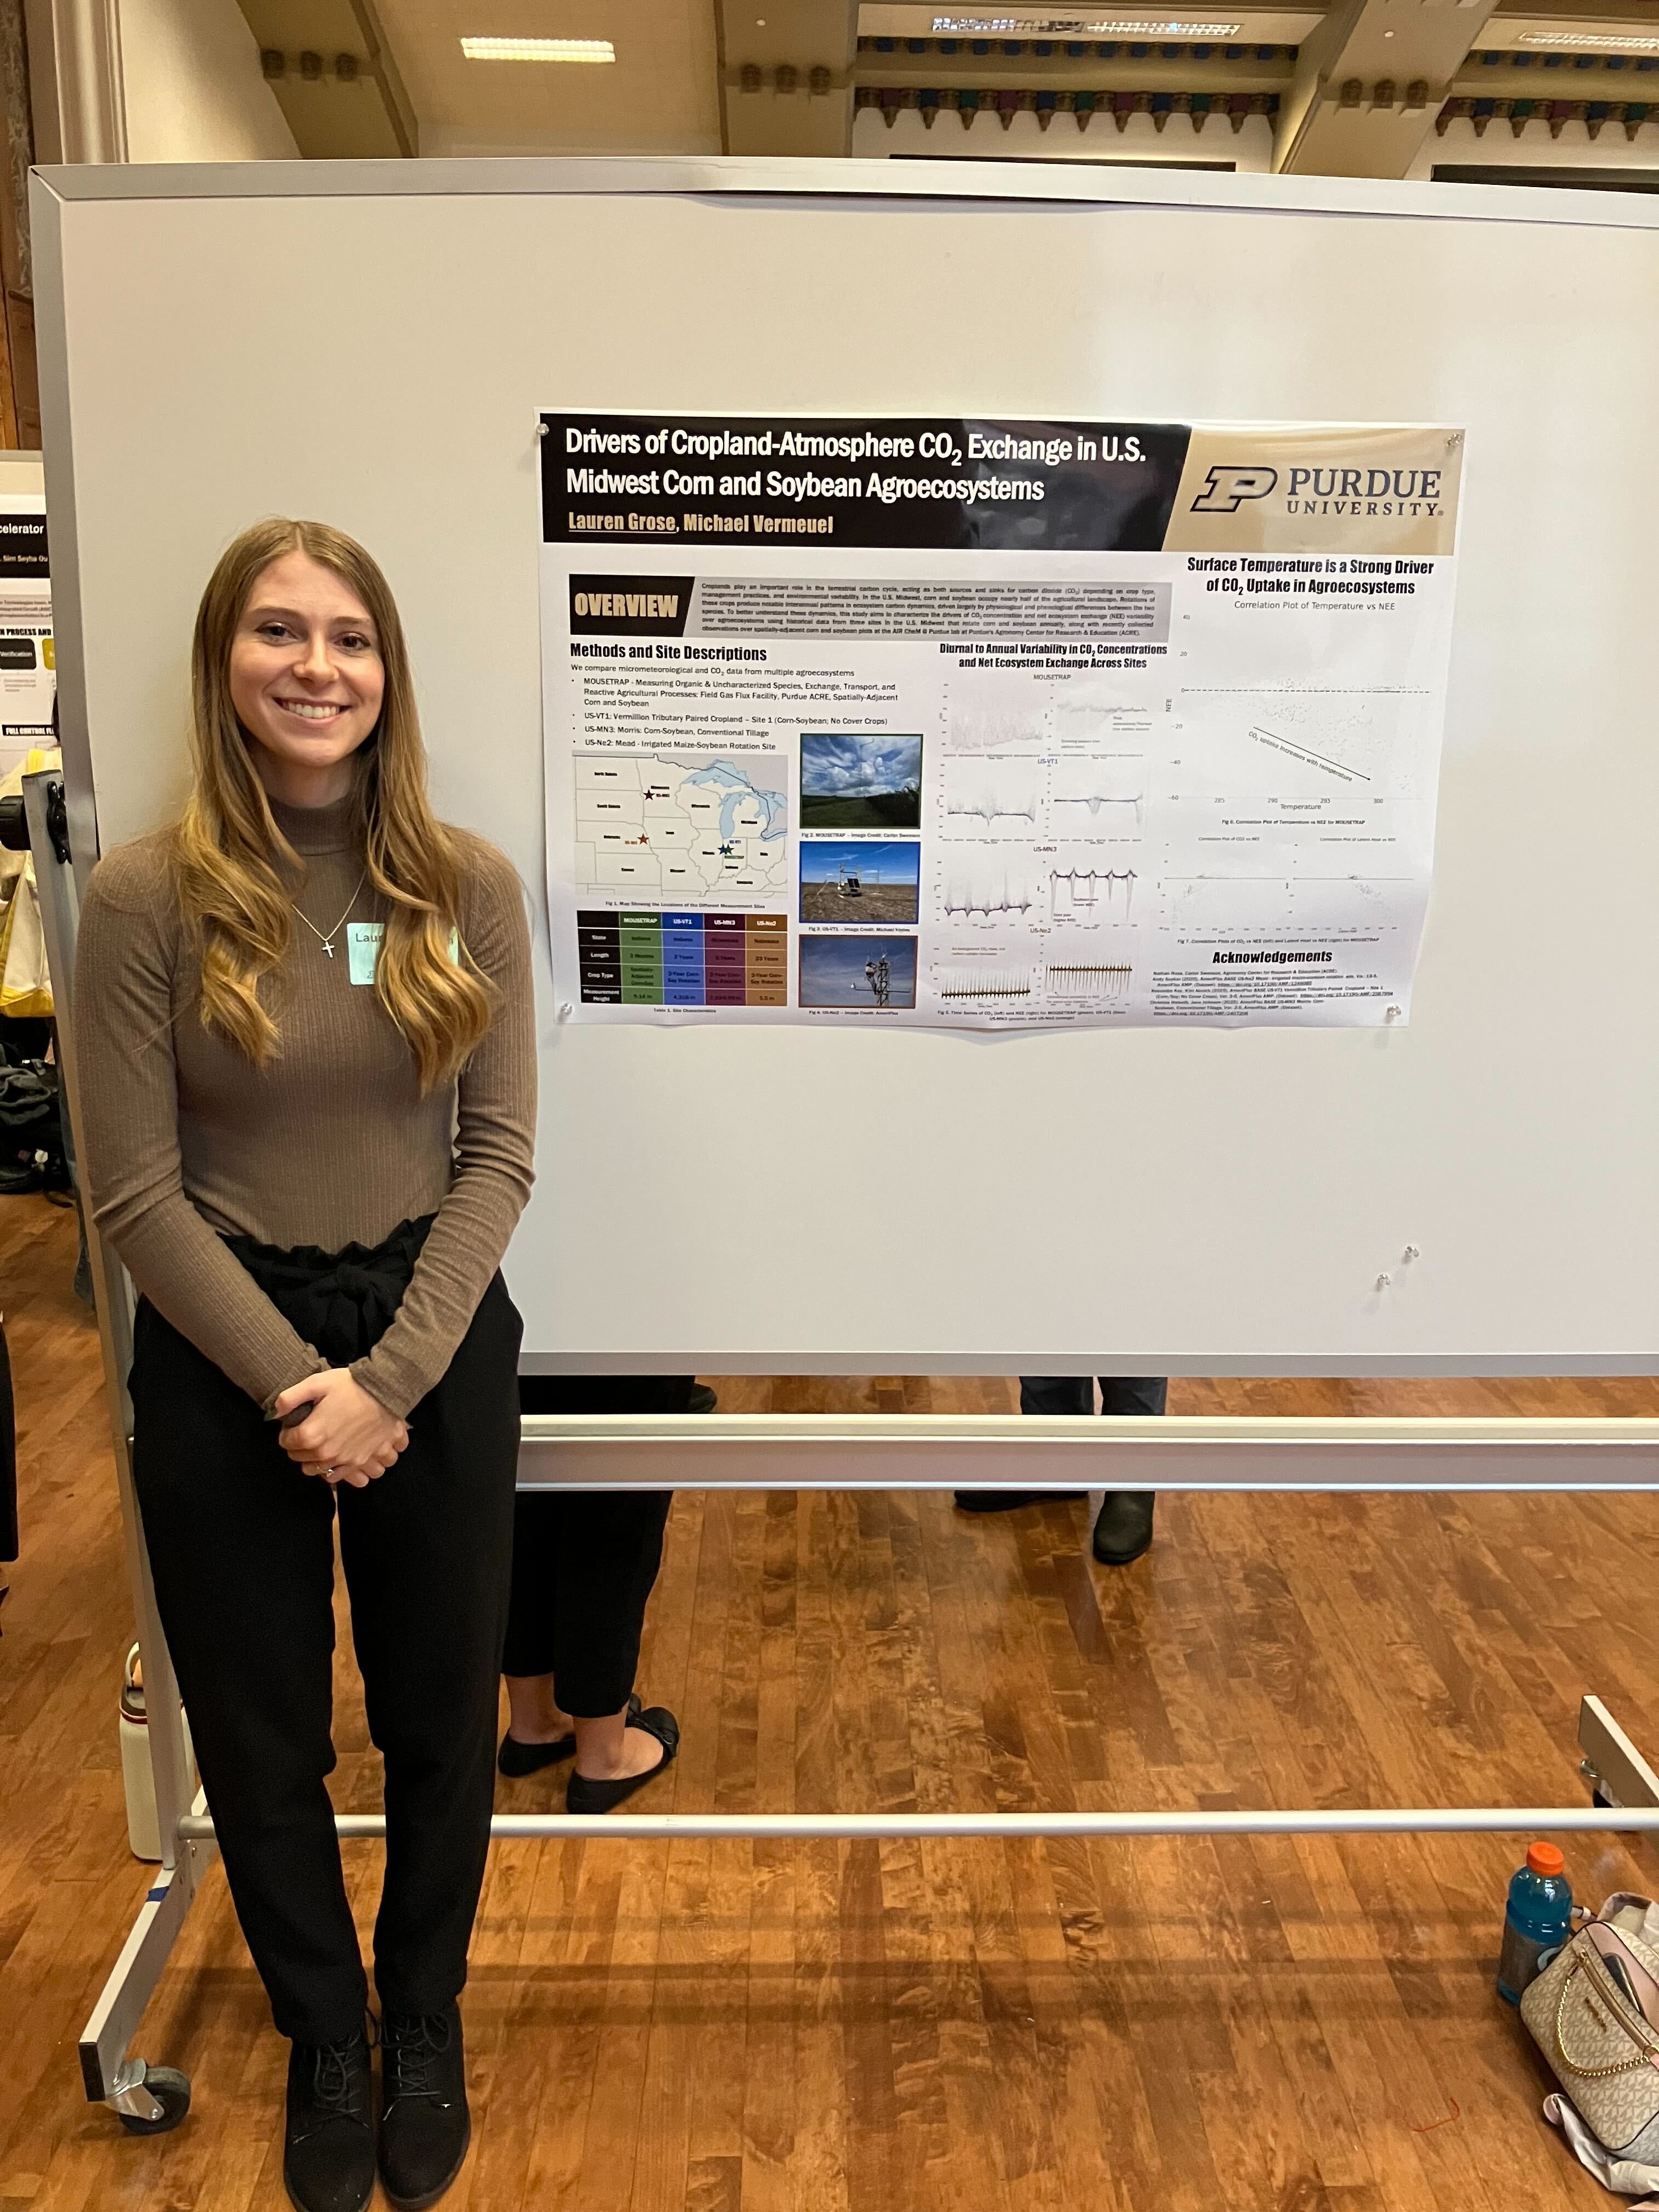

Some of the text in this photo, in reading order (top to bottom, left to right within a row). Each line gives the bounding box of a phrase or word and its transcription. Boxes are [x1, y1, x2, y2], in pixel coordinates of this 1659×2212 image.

[566, 428, 641, 453] Drivers
[645, 429, 669, 454] of
[671, 430, 915, 460] Cropland-Atmosphere
[968, 433, 1073, 465] Exchange
[1077, 436, 1097, 460] in
[1102, 436, 1146, 461] U.S.
[567, 469, 1045, 504] Midwest Corn and Soybean Agroecosystems
[1288, 467, 1442, 498] PURDUE
[568, 511, 834, 534] Lauren Grose, Michael Vermeuel
[1187, 557, 1434, 575] Surface Temperature is a Strong Driver
[1206, 578, 1220, 591] of
[1246, 578, 1290, 593] Uptake
[1293, 579, 1306, 592] in
[1308, 579, 1415, 594] Agroecosystems
[574, 592, 679, 618] OVERVIEW
[1234, 601, 1280, 609] Correlation
[1311, 601, 1363, 610] Temperature
[1378, 602, 1395, 611] NEE
[570, 643, 767, 661] Methods and Site Descriptions
[940, 643, 973, 653] Diurnal
[975, 644, 984, 653] to
[986, 644, 1018, 654] Annual
[1020, 644, 1067, 655] Variability
[1069, 644, 1078, 654] in
[1097, 644, 1167, 654] Concentrations
[958, 657, 1147, 669] and Net Ecosystem Exchange Across Sites
[618, 666, 693, 675] micrometeorological
[635, 679, 674, 688] Measuring
[675, 680, 703, 689] Organic
[805, 682, 842, 691] Exchange,
[843, 683, 880, 691] Transport,
[617, 689, 658, 697] Agricultural
[833, 693, 898, 702] Spatially-Adjacent
[618, 699, 649, 708] Soybean
[651, 714, 684, 723] Tributary
[644, 727, 695, 735] Corn-Soybean,
[745, 729, 769, 738] Tillage
[674, 741, 727, 749] Maize-Soybean
[1260, 737, 1279, 749] uptake
[1306, 758, 1318, 766] with
[1319, 763, 1352, 782] temperature
[1212, 951, 1333, 963] Acknowledgements
